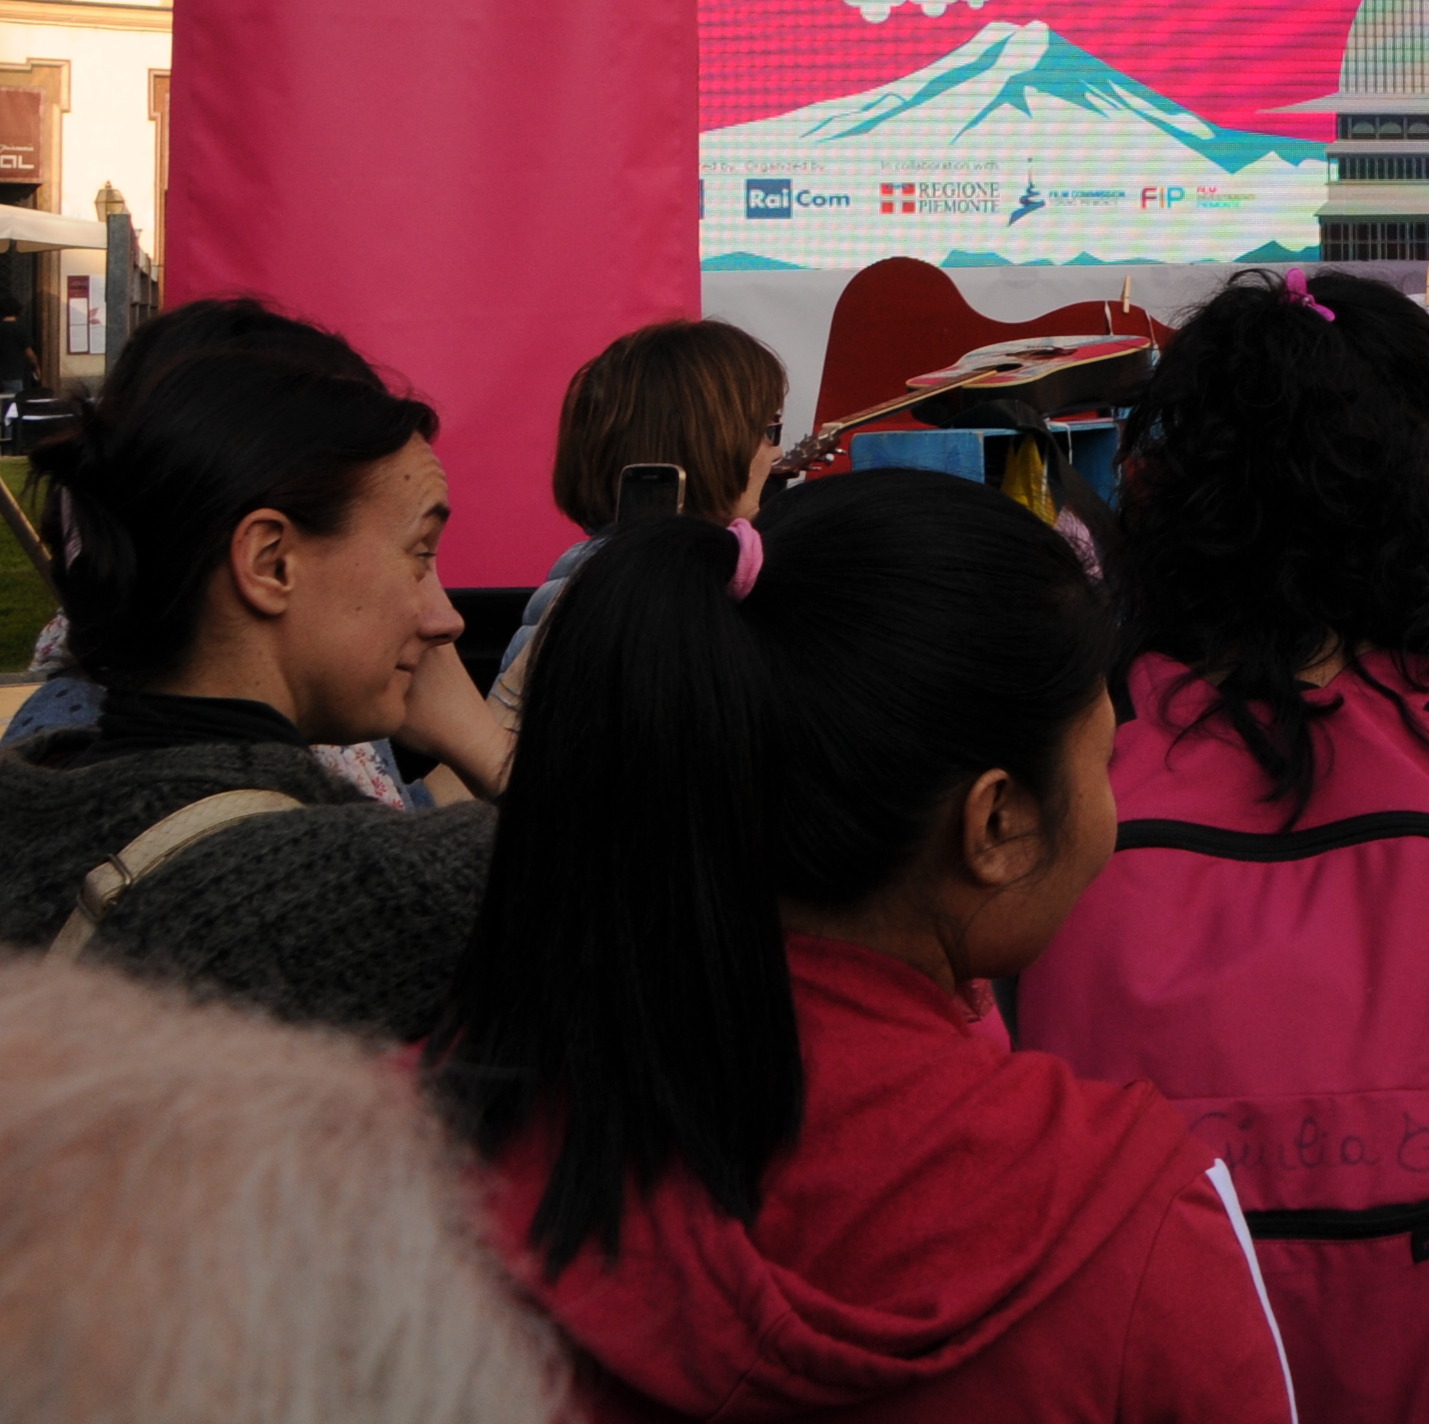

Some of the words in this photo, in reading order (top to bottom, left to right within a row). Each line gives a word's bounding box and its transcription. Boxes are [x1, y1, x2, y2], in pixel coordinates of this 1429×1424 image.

[750, 189, 790, 209] Rai
[796, 190, 850, 208] Com
[919, 182, 1000, 198] REGIONE
[1140, 187, 1185, 209] FIP
[919, 199, 1000, 214] PIEMONTE
